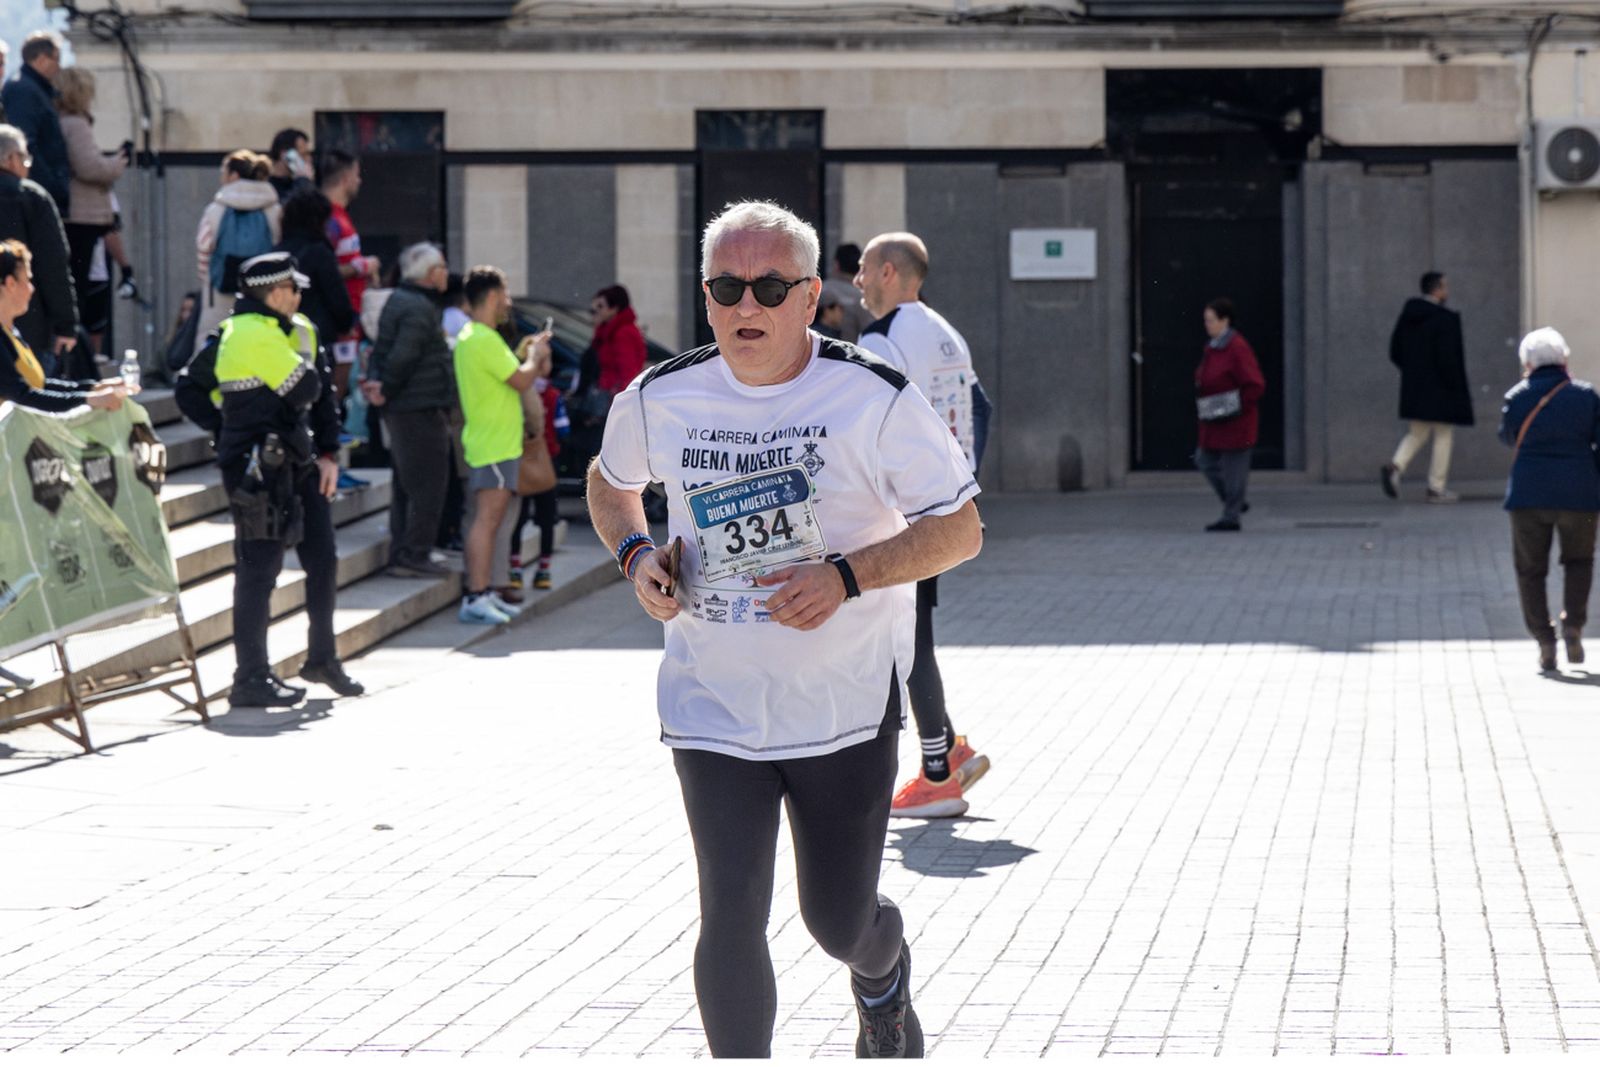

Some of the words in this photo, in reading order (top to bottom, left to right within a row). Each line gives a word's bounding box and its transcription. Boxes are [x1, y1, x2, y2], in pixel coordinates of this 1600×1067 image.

[686, 428, 698, 440] VI
[699, 429, 758, 445] CARRERA
[761, 425, 828, 443] CAMINATA
[681, 447, 730, 471] BUENA
[735, 446, 793, 473] MUERTE
[702, 496, 712, 505] VI
[713, 485, 751, 503] CARRERA
[750, 474, 793, 491] CAMINATA
[706, 504, 738, 522] BUENA
[740, 491, 779, 512] MUERTE
[724, 508, 794, 555] 334
